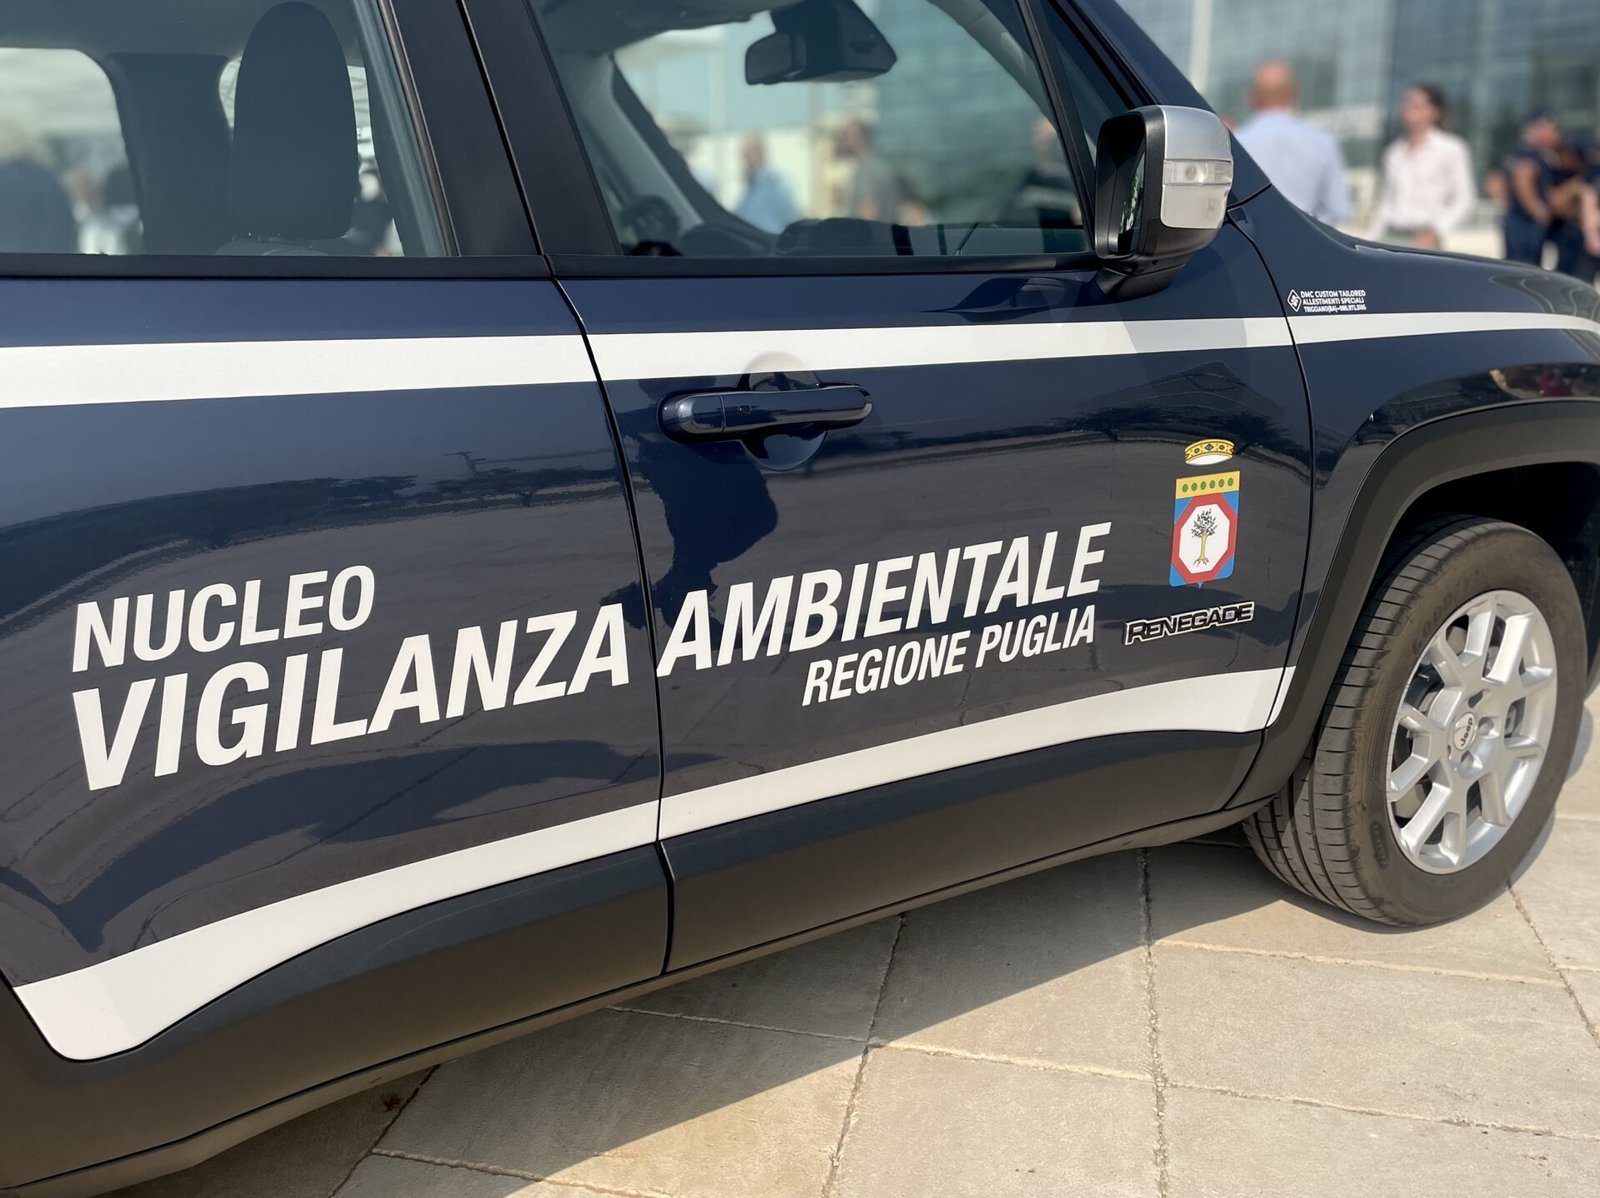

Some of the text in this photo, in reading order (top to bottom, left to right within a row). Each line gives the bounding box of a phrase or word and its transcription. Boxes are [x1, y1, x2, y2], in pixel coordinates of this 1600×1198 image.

[1303, 298, 1340, 306] ALLESTIMENTI
[1315, 290, 1338, 298] CUSTOM
[72, 565, 375, 672] NUCLEO
[1124, 600, 1255, 645] RENEGADE
[72, 522, 1111, 791] VIGILANZA AMBIENTALE
[802, 605, 1096, 707] REGIONE PUGLIA
[1459, 717, 1474, 747] Jeep
